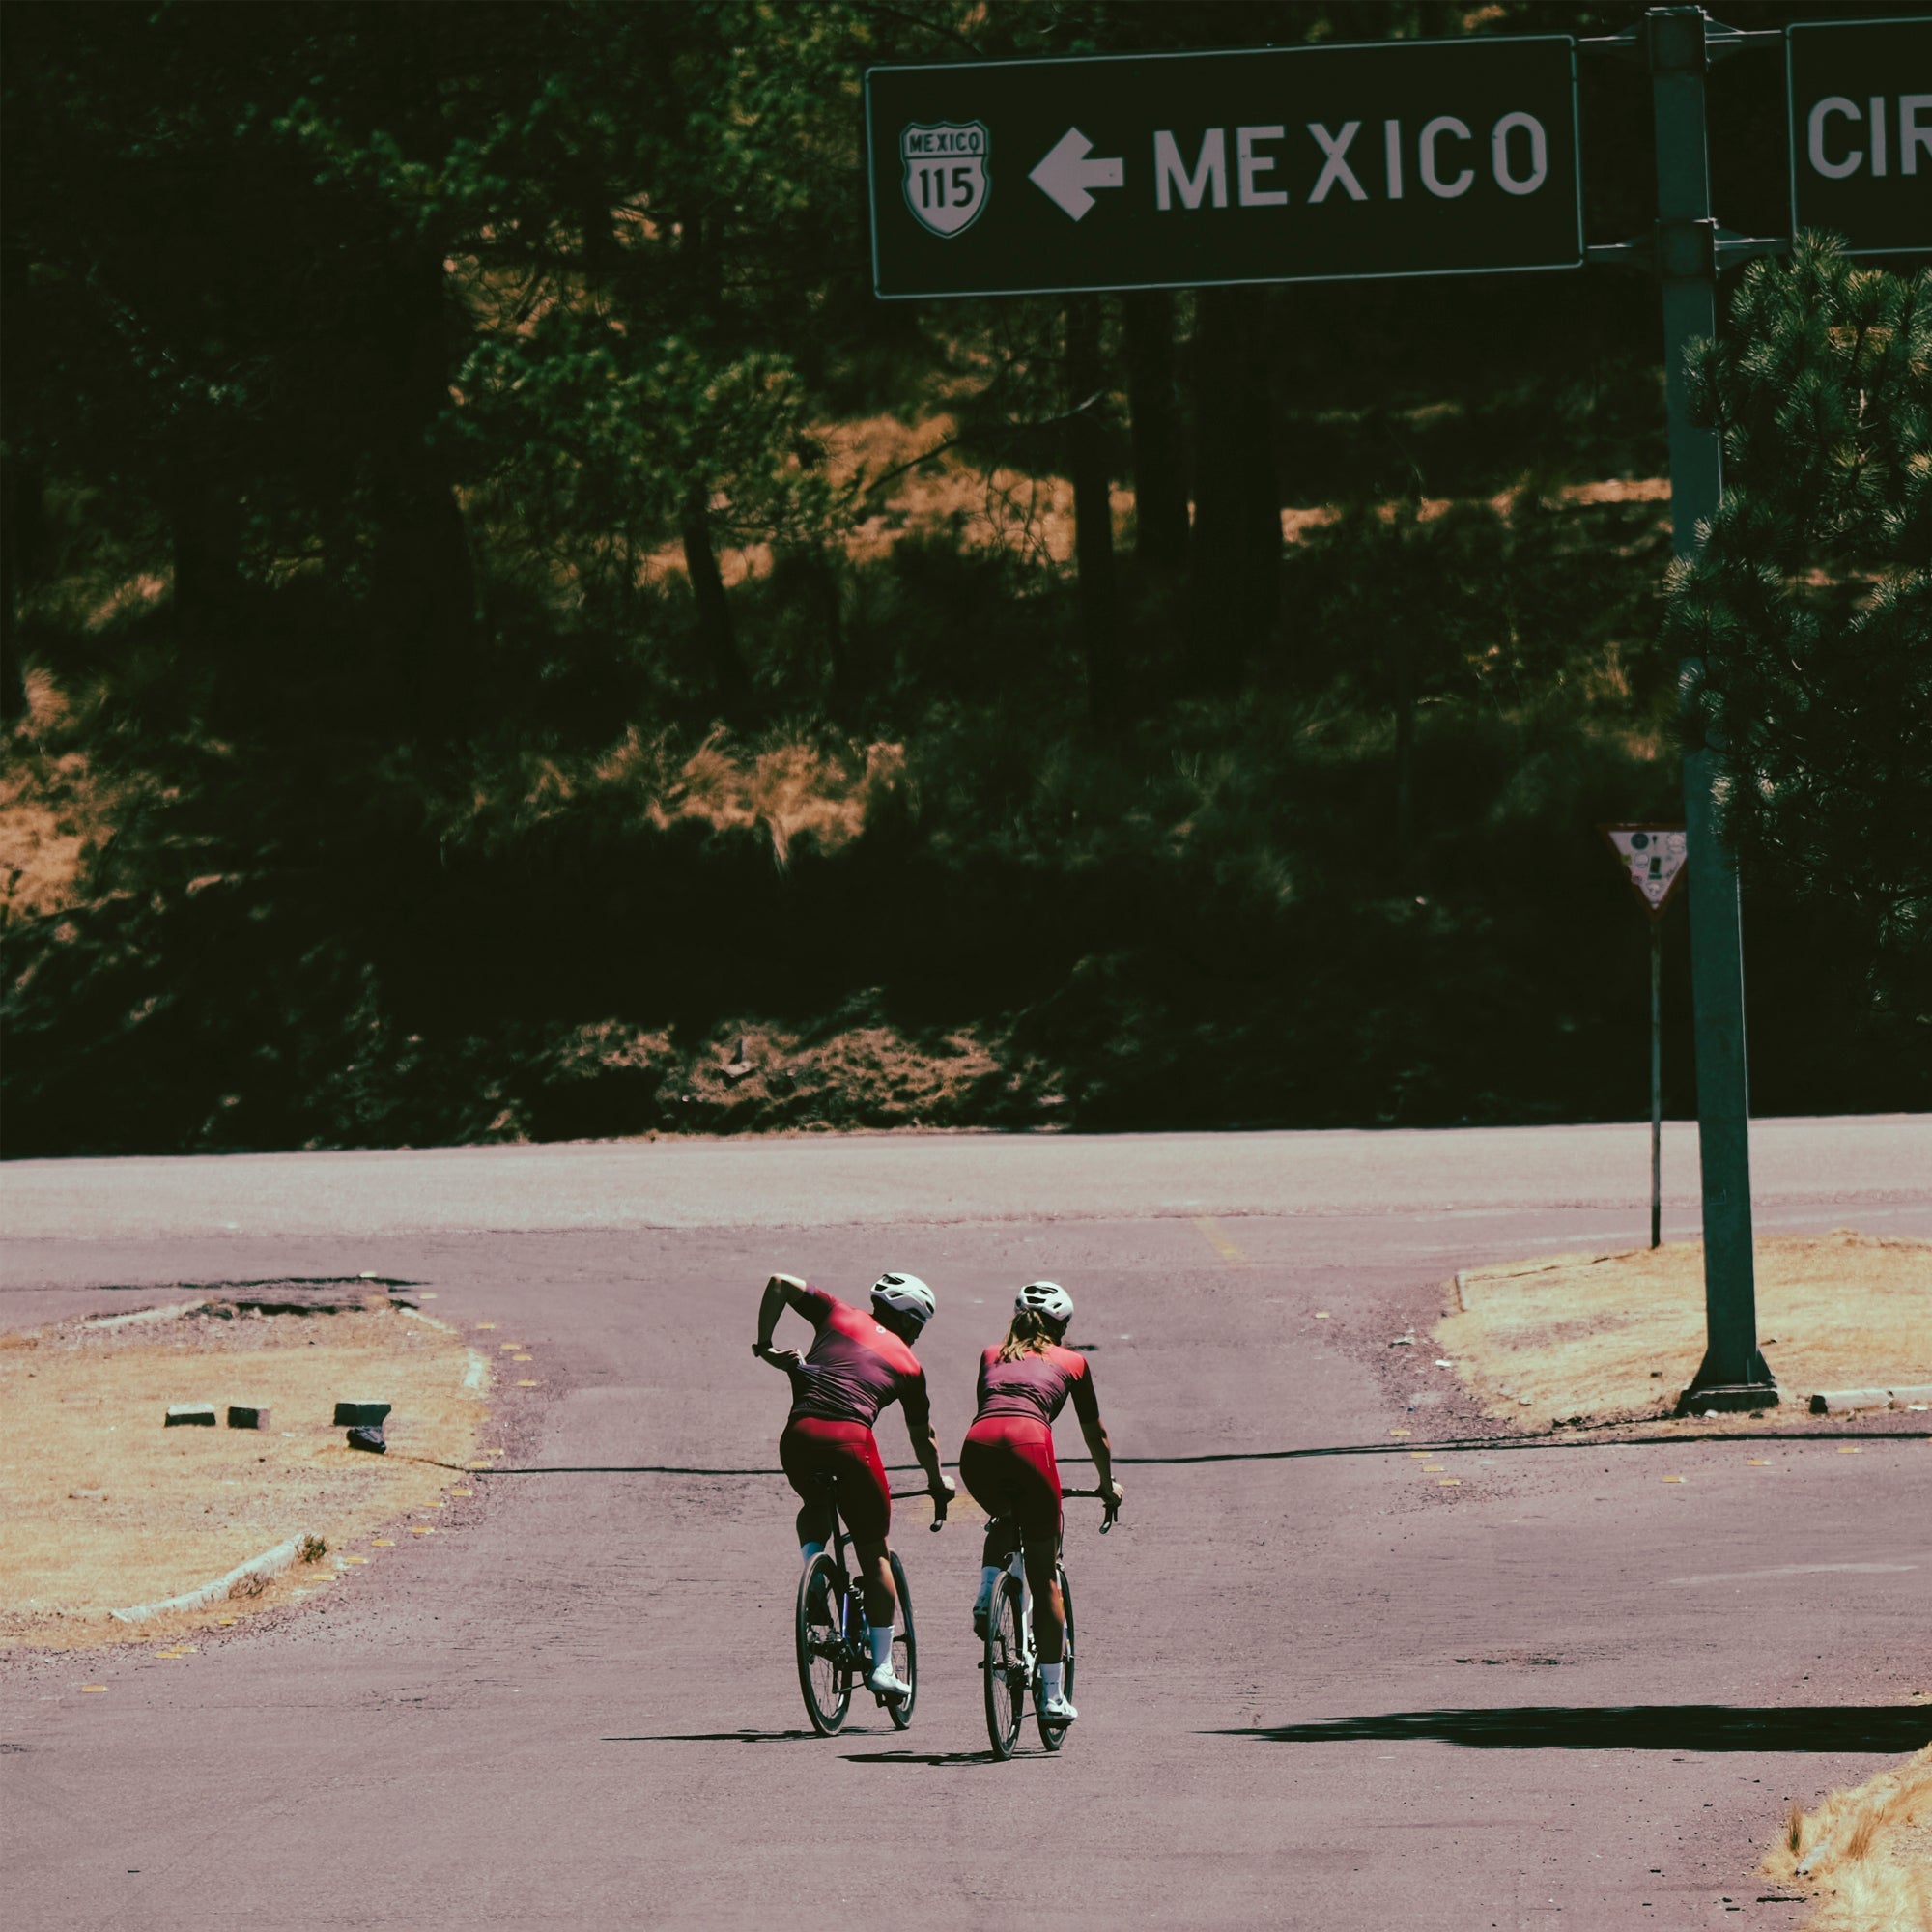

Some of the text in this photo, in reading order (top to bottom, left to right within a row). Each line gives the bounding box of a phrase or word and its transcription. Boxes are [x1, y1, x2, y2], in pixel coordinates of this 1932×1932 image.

[909, 132, 980, 153] MEXICO
[1153, 111, 1548, 211] MEXICO
[919, 167, 974, 208] 115
